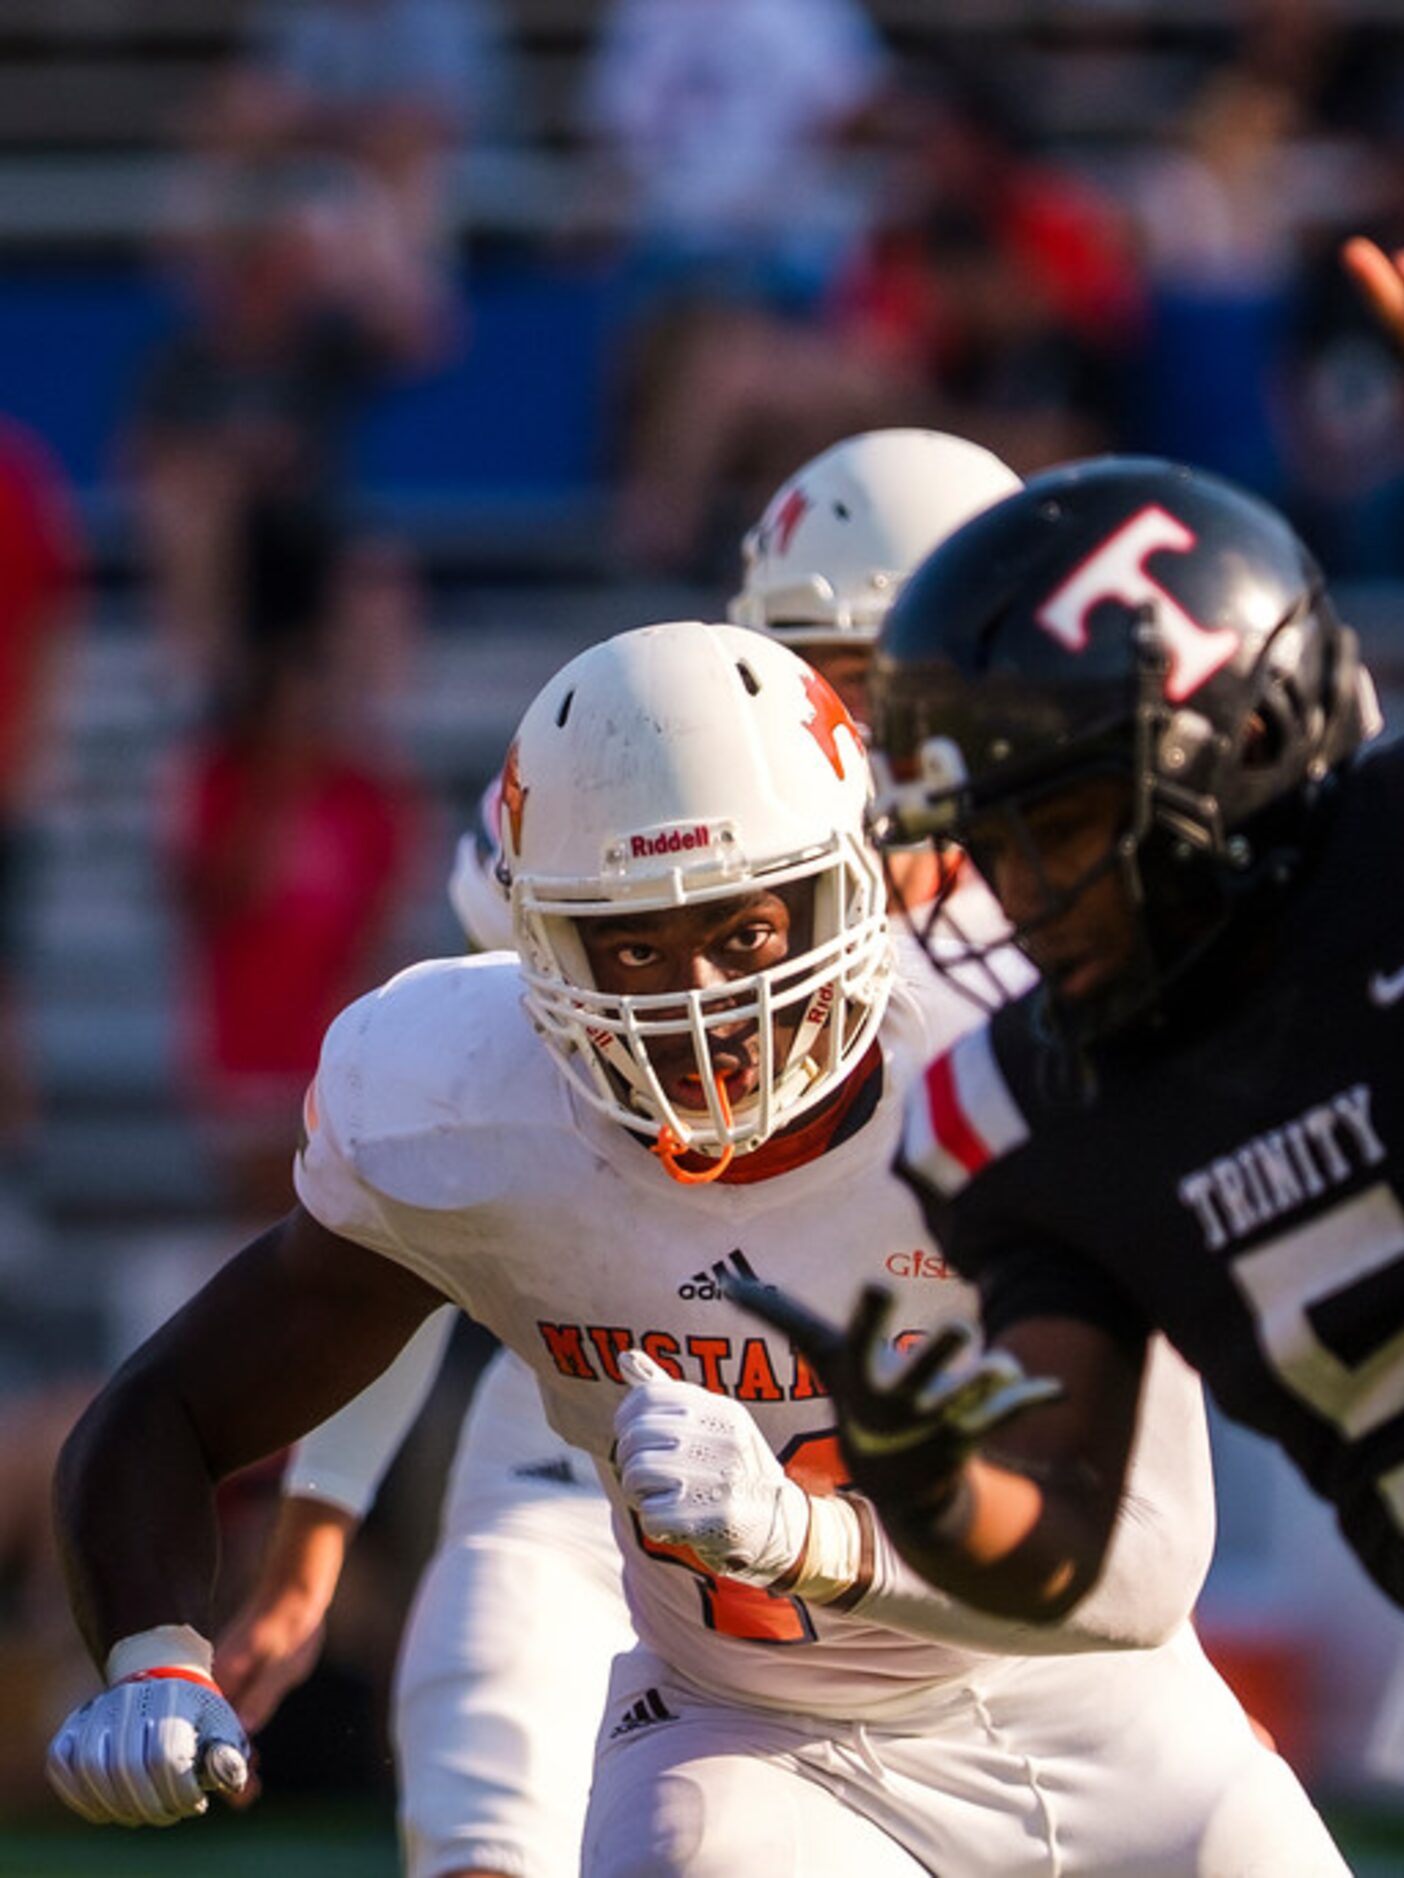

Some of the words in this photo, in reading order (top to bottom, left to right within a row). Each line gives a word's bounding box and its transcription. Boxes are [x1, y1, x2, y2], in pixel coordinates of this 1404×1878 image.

[1034, 500, 1241, 707] T
[630, 825, 709, 858] Riddell
[1178, 1081, 1386, 1252] TRINITY
